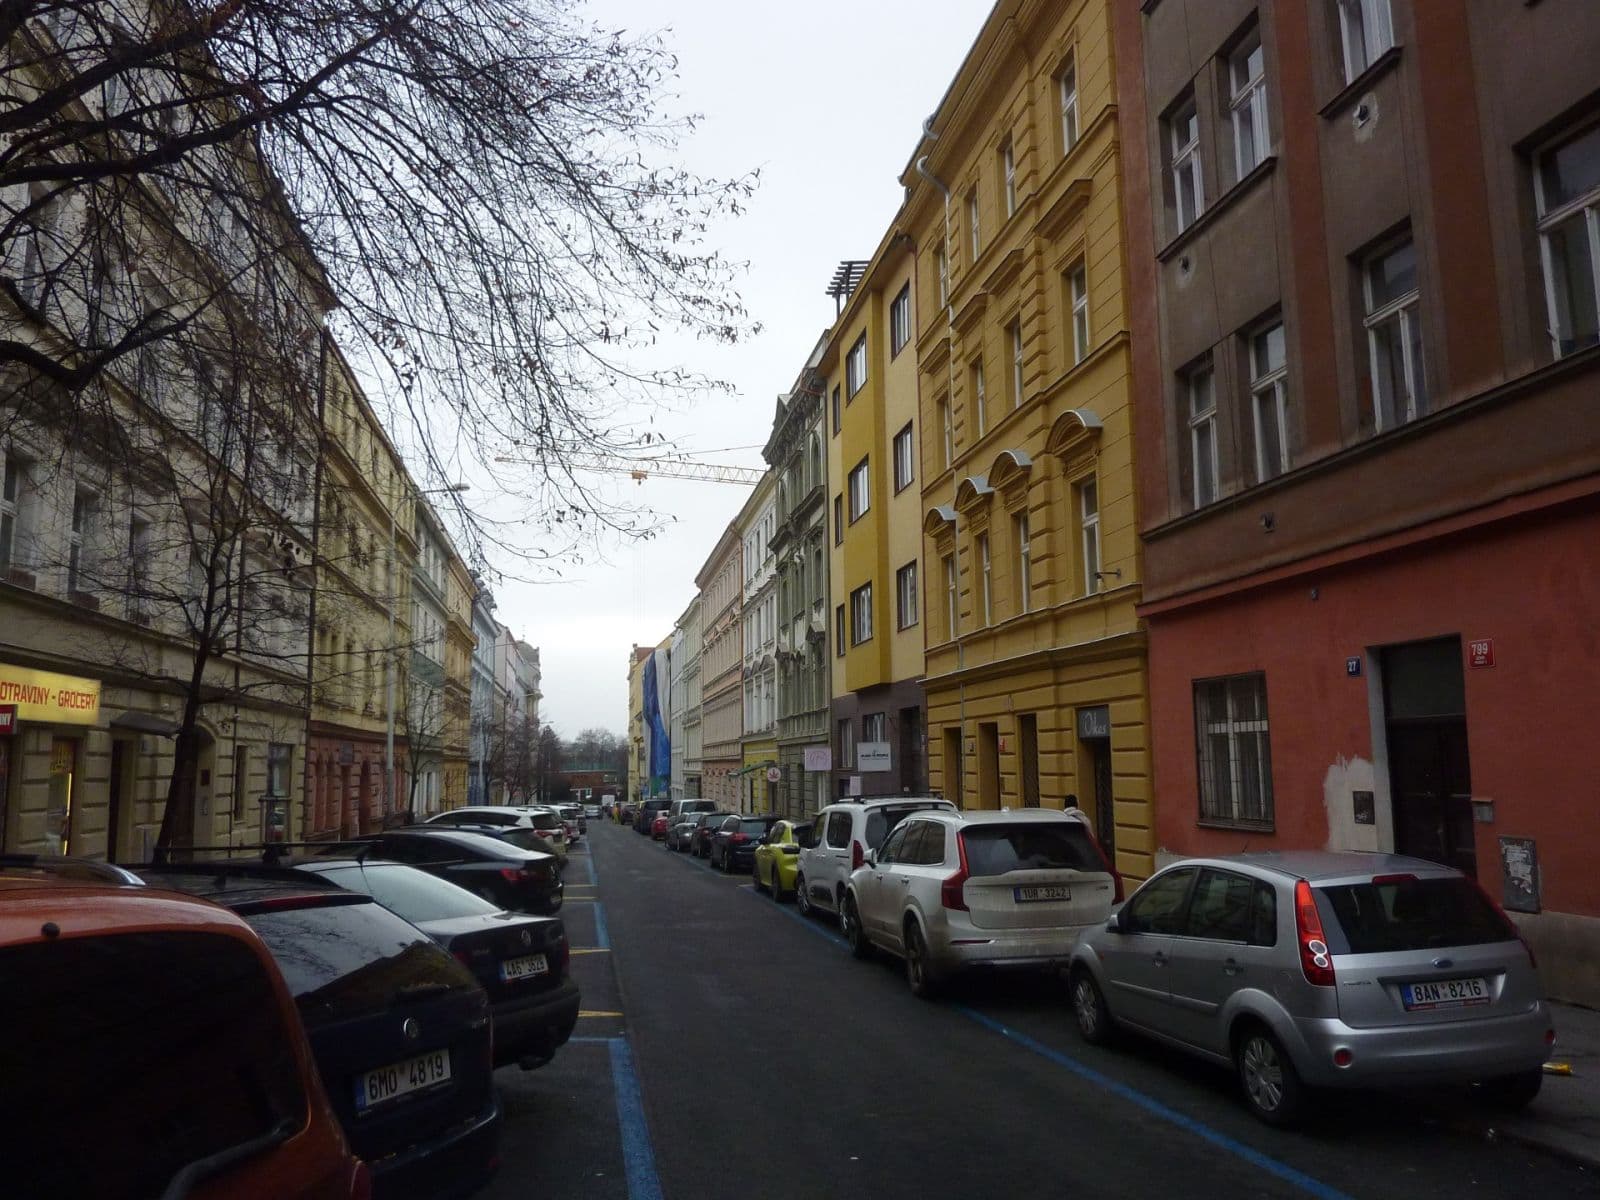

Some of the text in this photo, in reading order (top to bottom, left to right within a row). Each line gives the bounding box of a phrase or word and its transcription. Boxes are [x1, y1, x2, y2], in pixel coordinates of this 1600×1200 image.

[58, 689, 97, 710] GROCERY
[1414, 981, 1481, 1001] 8AN 8216
[409, 1054, 444, 1086] 4819
